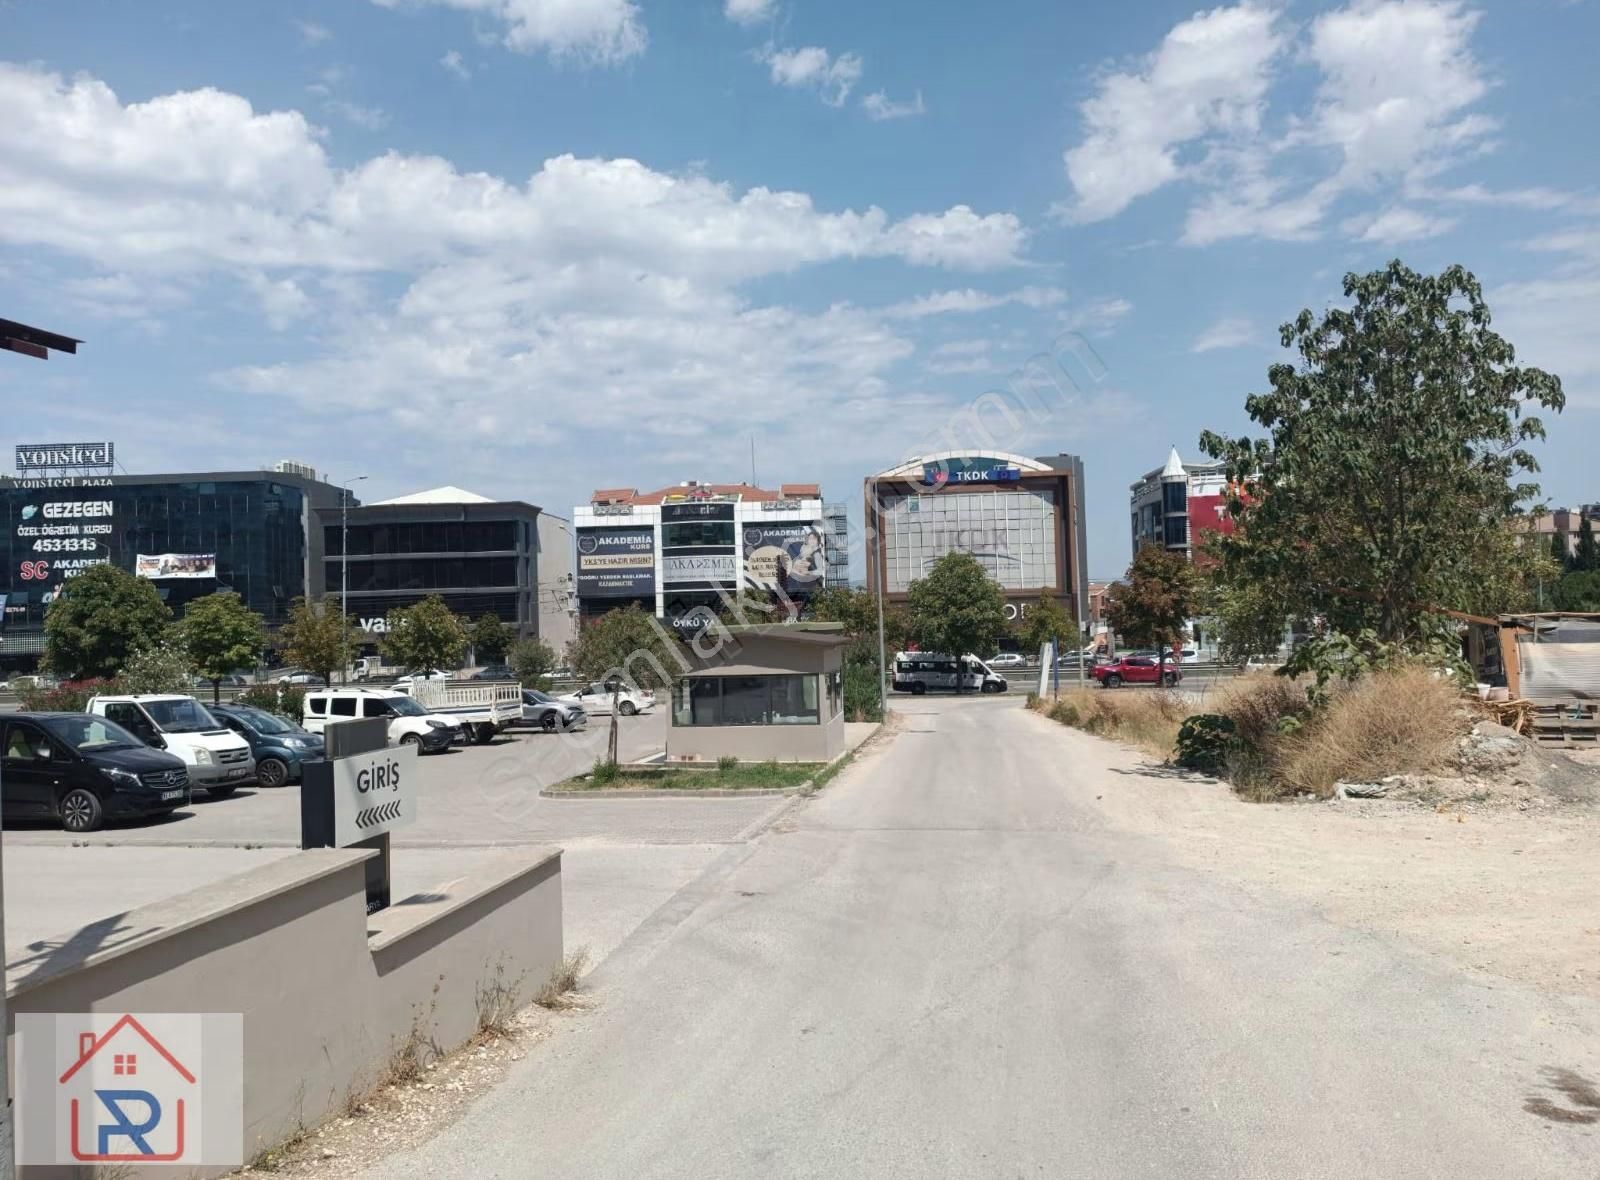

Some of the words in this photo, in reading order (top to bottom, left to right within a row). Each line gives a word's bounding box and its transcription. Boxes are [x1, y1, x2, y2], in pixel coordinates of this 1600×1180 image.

[82, 479, 113, 487] PLAZA
[956, 470, 989, 481] TKDK
[42, 501, 113, 518] GEZEGEN
[17, 524, 40, 537] ÖZEL
[41, 523, 79, 535] ÖĞRETİM
[83, 524, 112, 534] KURSU
[20, 560, 49, 580] SC
[356, 758, 400, 794] GİRİŞ
